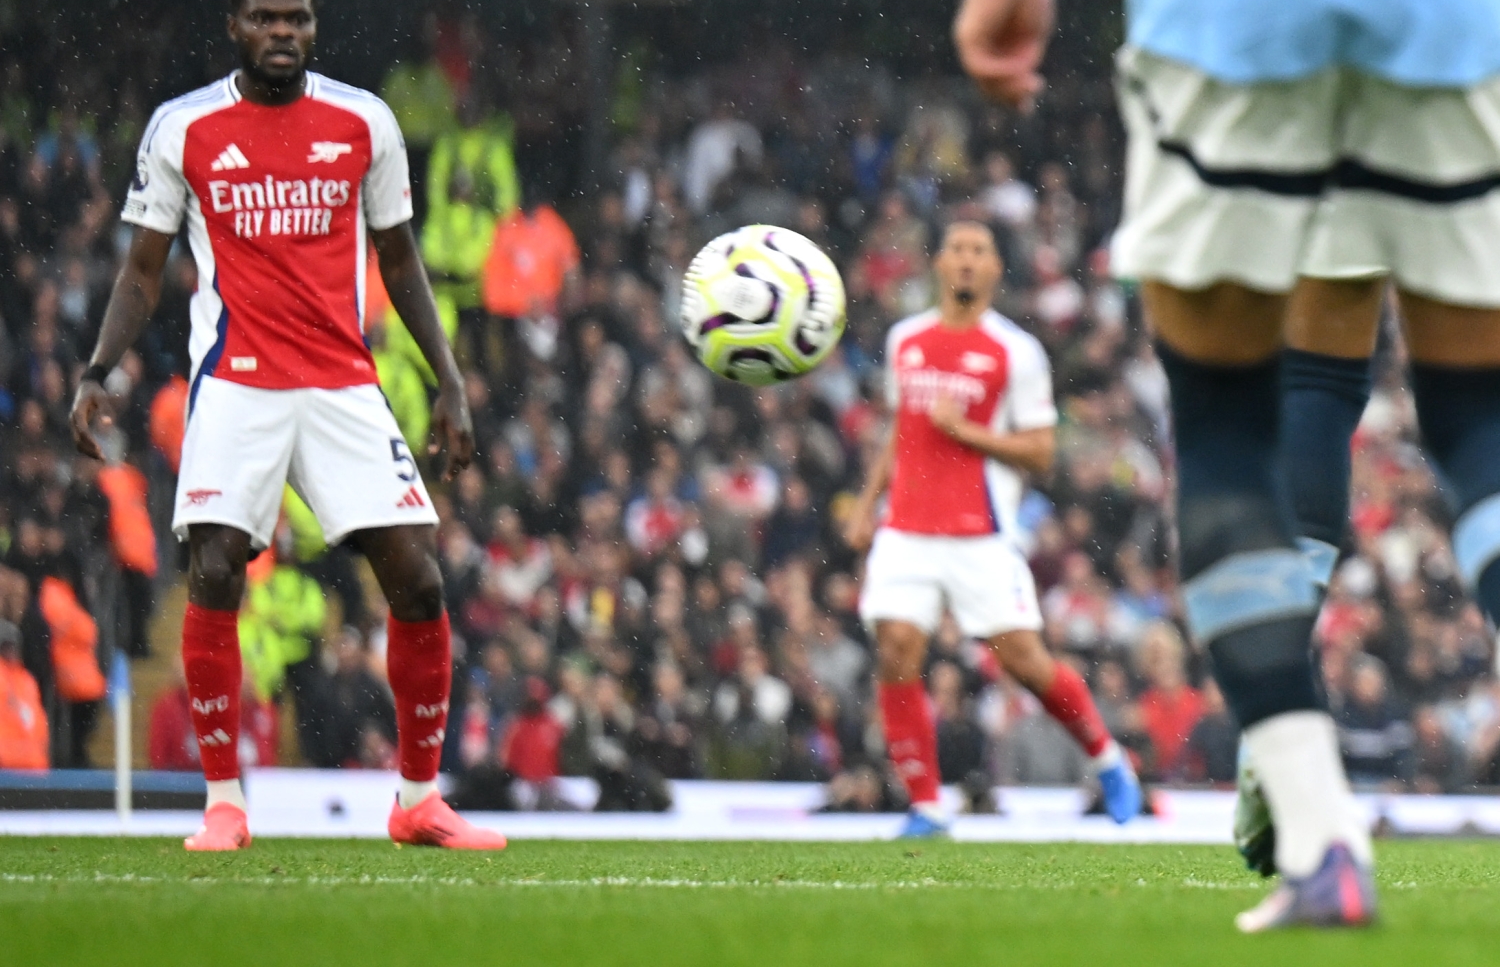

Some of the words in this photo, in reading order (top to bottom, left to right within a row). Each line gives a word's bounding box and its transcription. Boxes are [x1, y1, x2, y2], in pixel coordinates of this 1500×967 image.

[208, 174, 351, 213] Emirates
[234, 210, 264, 238] FLY
[269, 207, 333, 236] BETTER
[390, 438, 417, 482] 5
